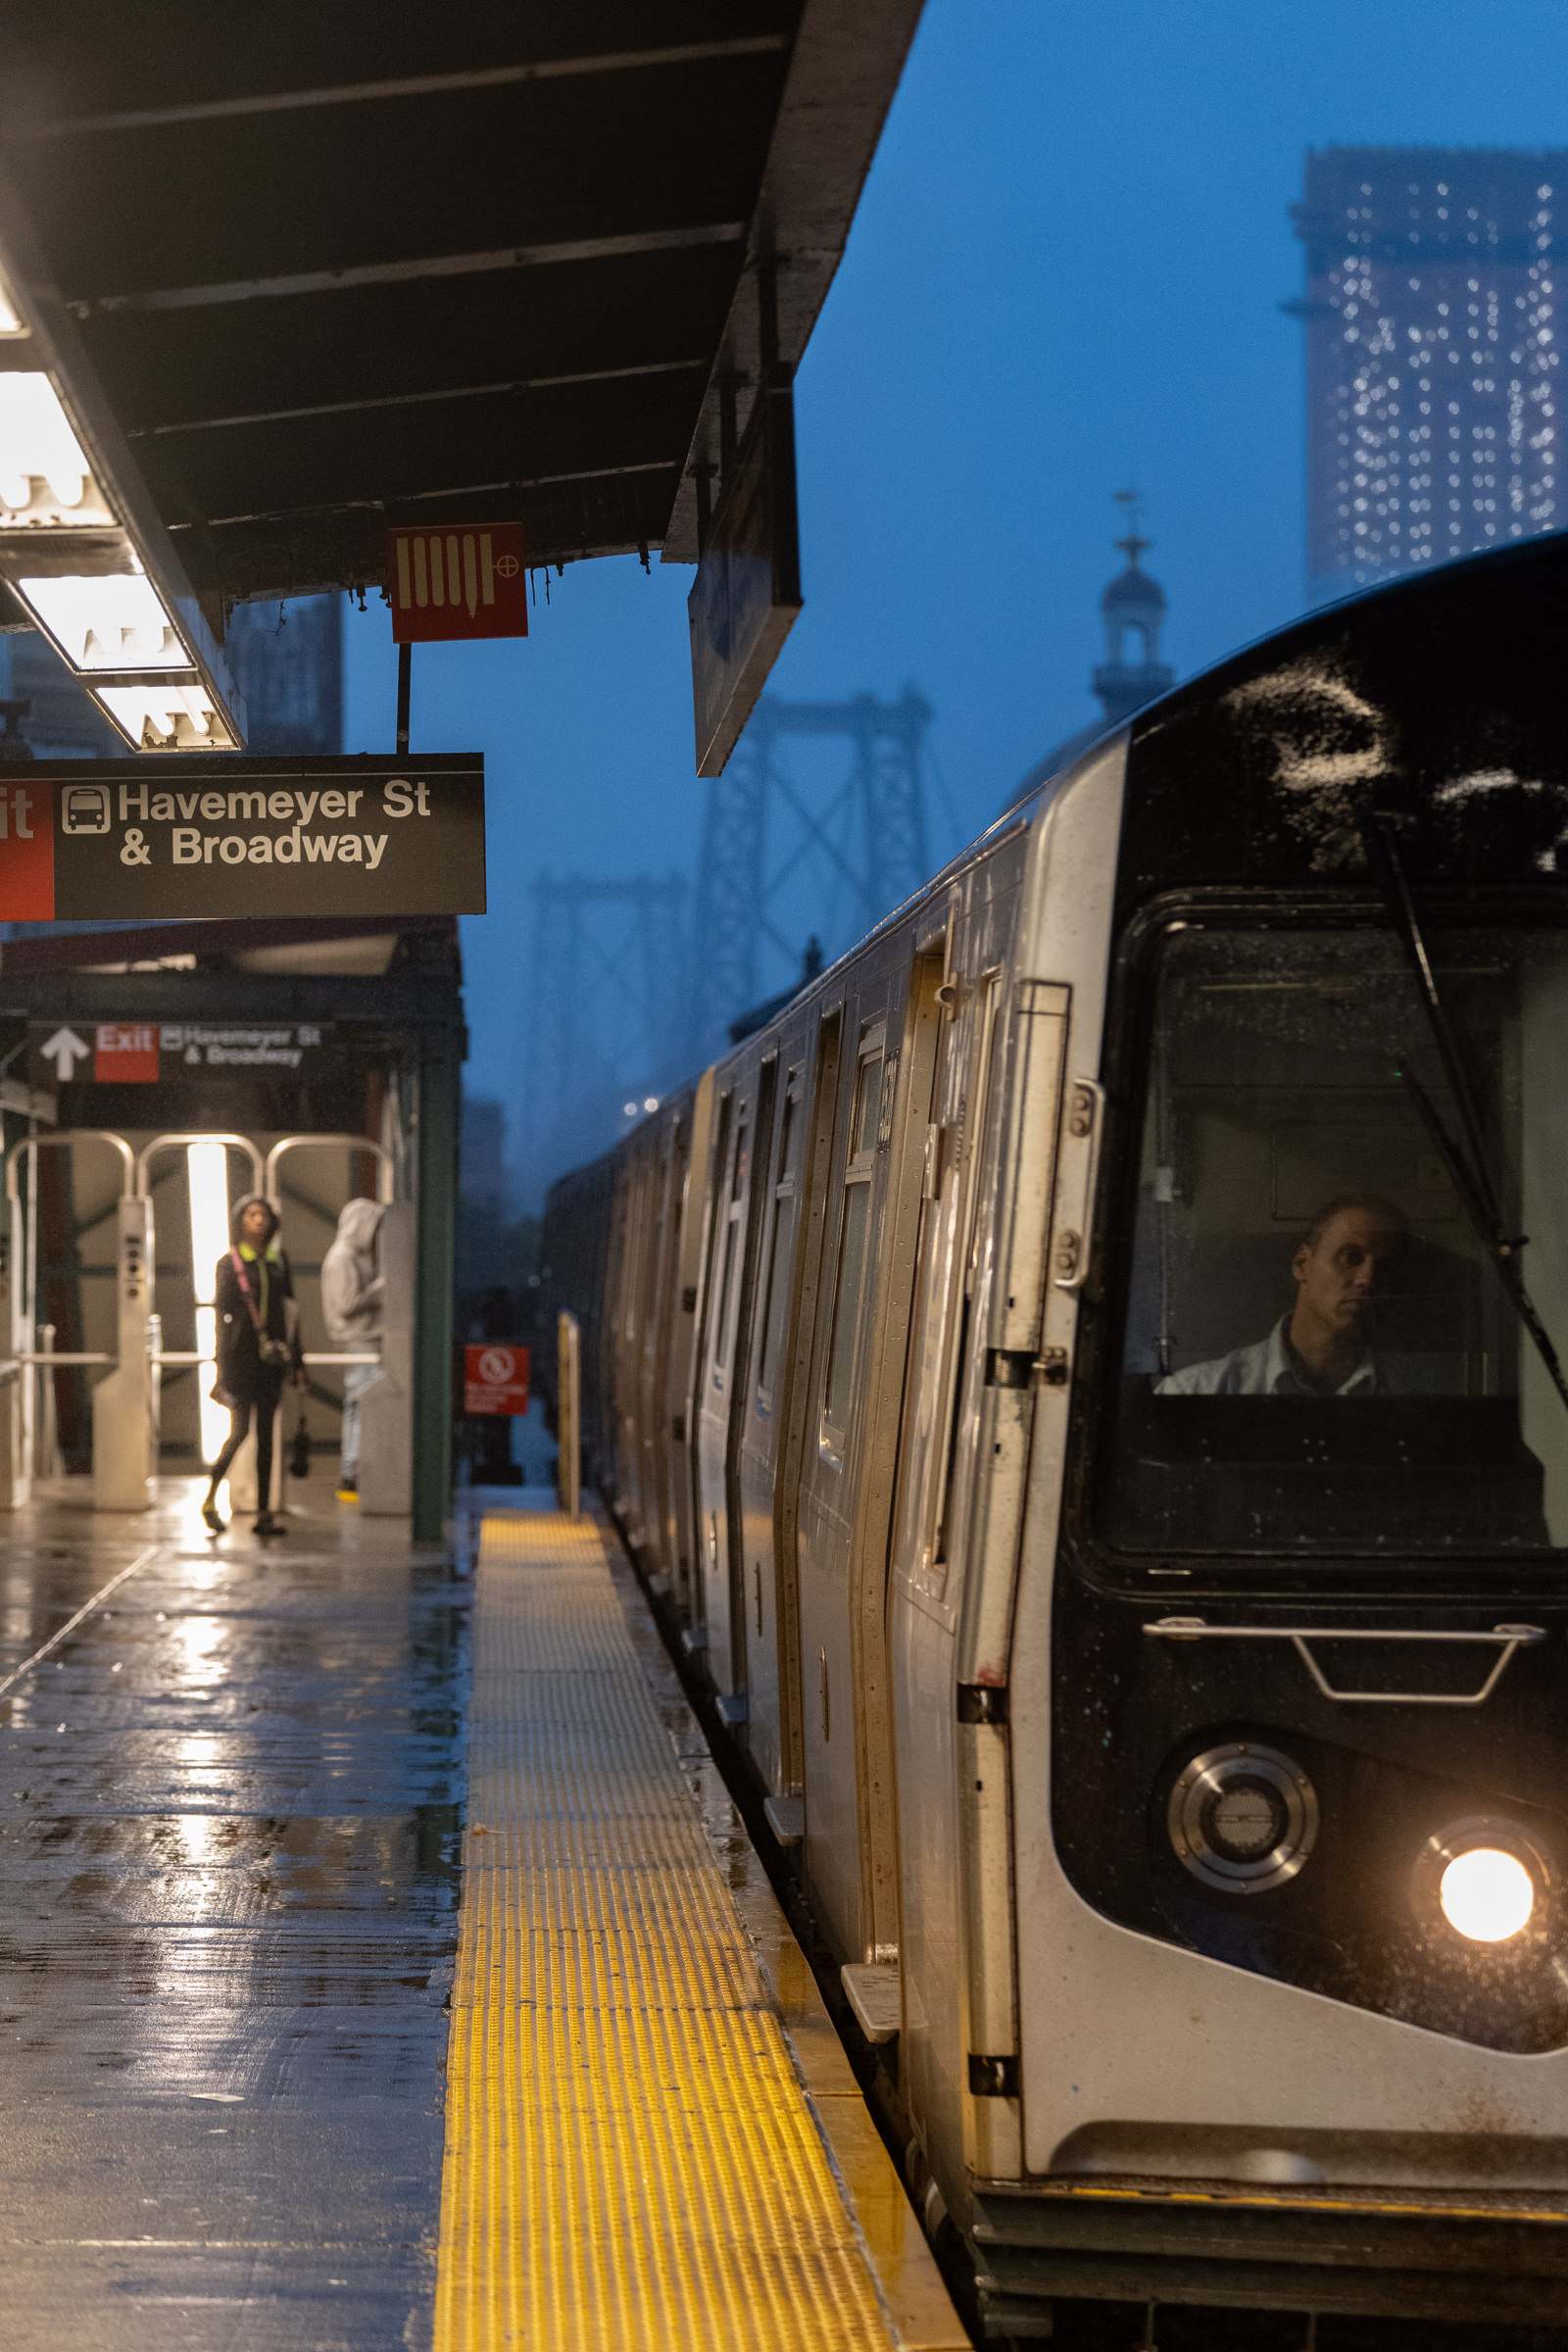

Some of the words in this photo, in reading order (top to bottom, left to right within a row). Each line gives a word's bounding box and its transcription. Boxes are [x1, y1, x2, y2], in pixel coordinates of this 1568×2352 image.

[119, 784, 364, 825] Havemeyer
[382, 779, 431, 817] St
[119, 828, 152, 866] &
[172, 826, 389, 869] Broadway
[96, 1025, 153, 1052] Exit
